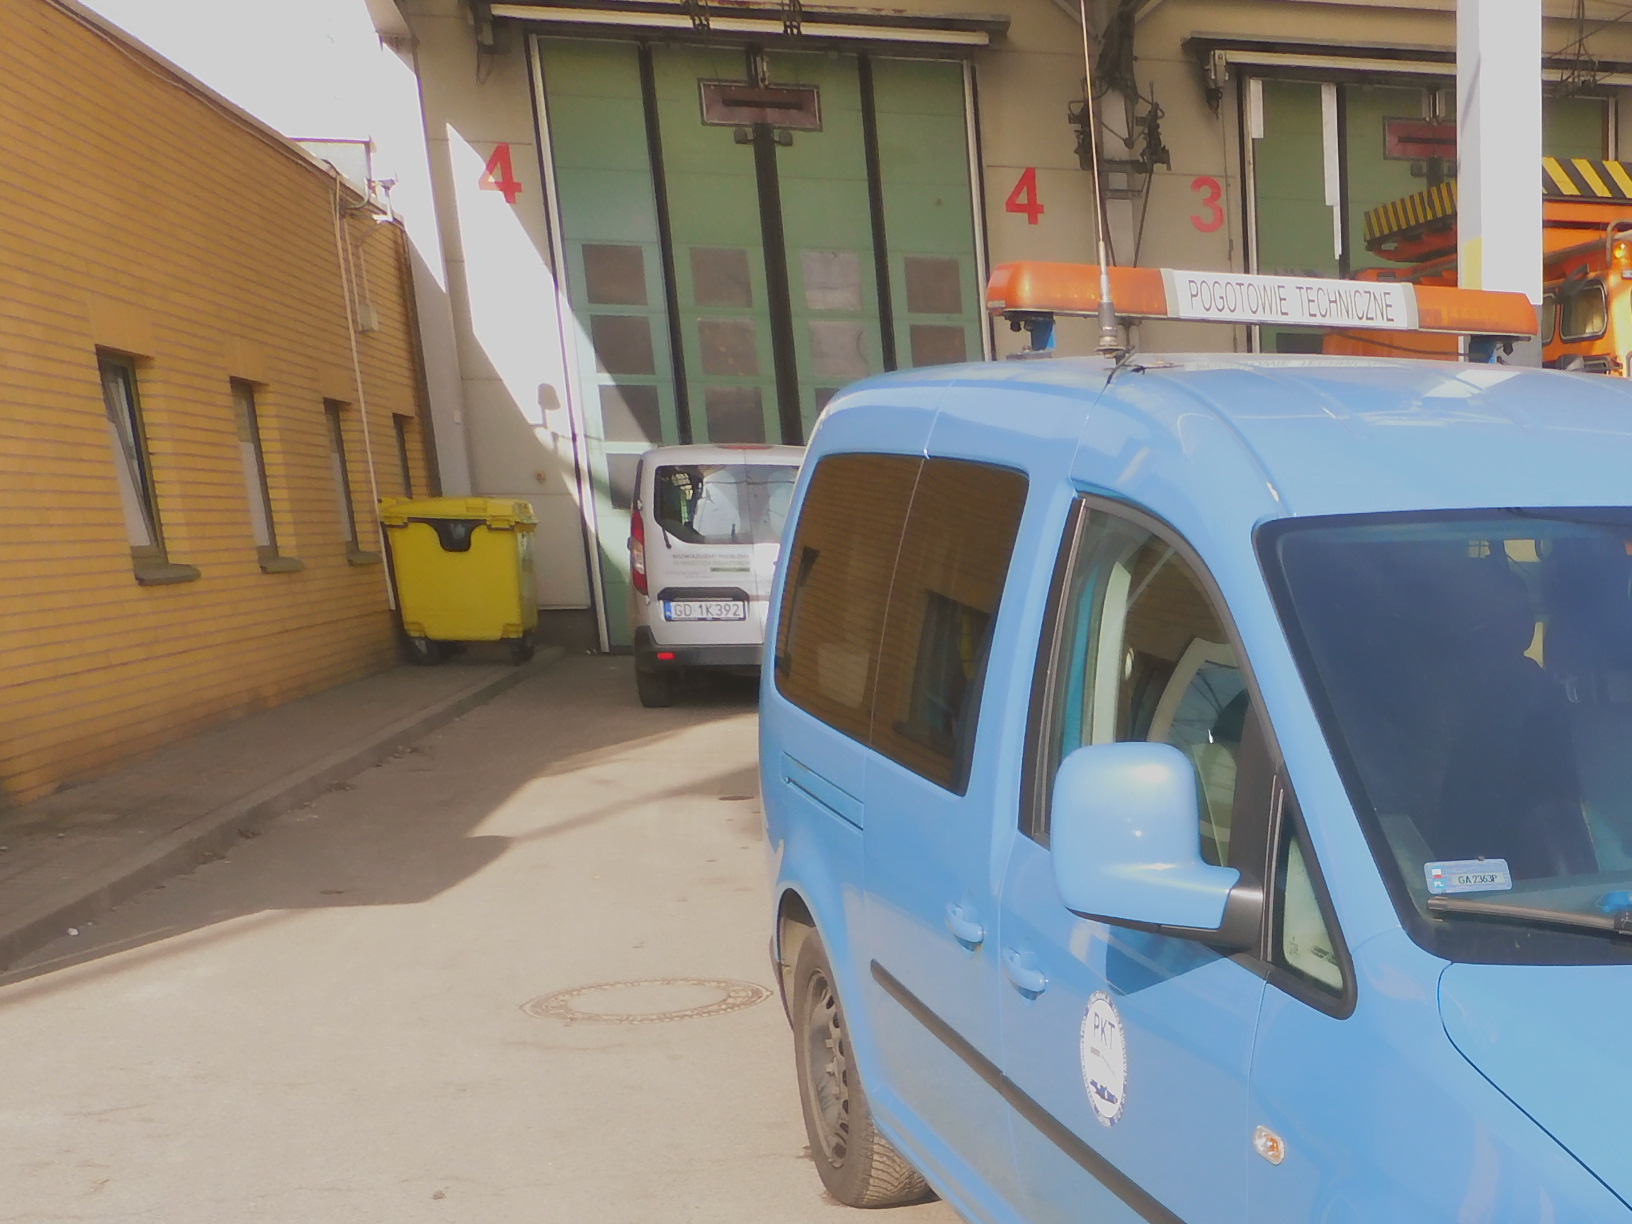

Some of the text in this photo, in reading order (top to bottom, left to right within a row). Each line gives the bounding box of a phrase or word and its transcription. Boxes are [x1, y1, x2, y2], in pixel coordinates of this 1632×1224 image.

[479, 142, 523, 204] 4
[1005, 166, 1045, 225] 4
[1190, 175, 1225, 233] 3
[1187, 279, 1395, 322] POGOTOWIE TECHNICZNE
[674, 604, 692, 617] GD
[699, 604, 740, 617] 1K392
[1093, 1011, 1116, 1050] PKT
